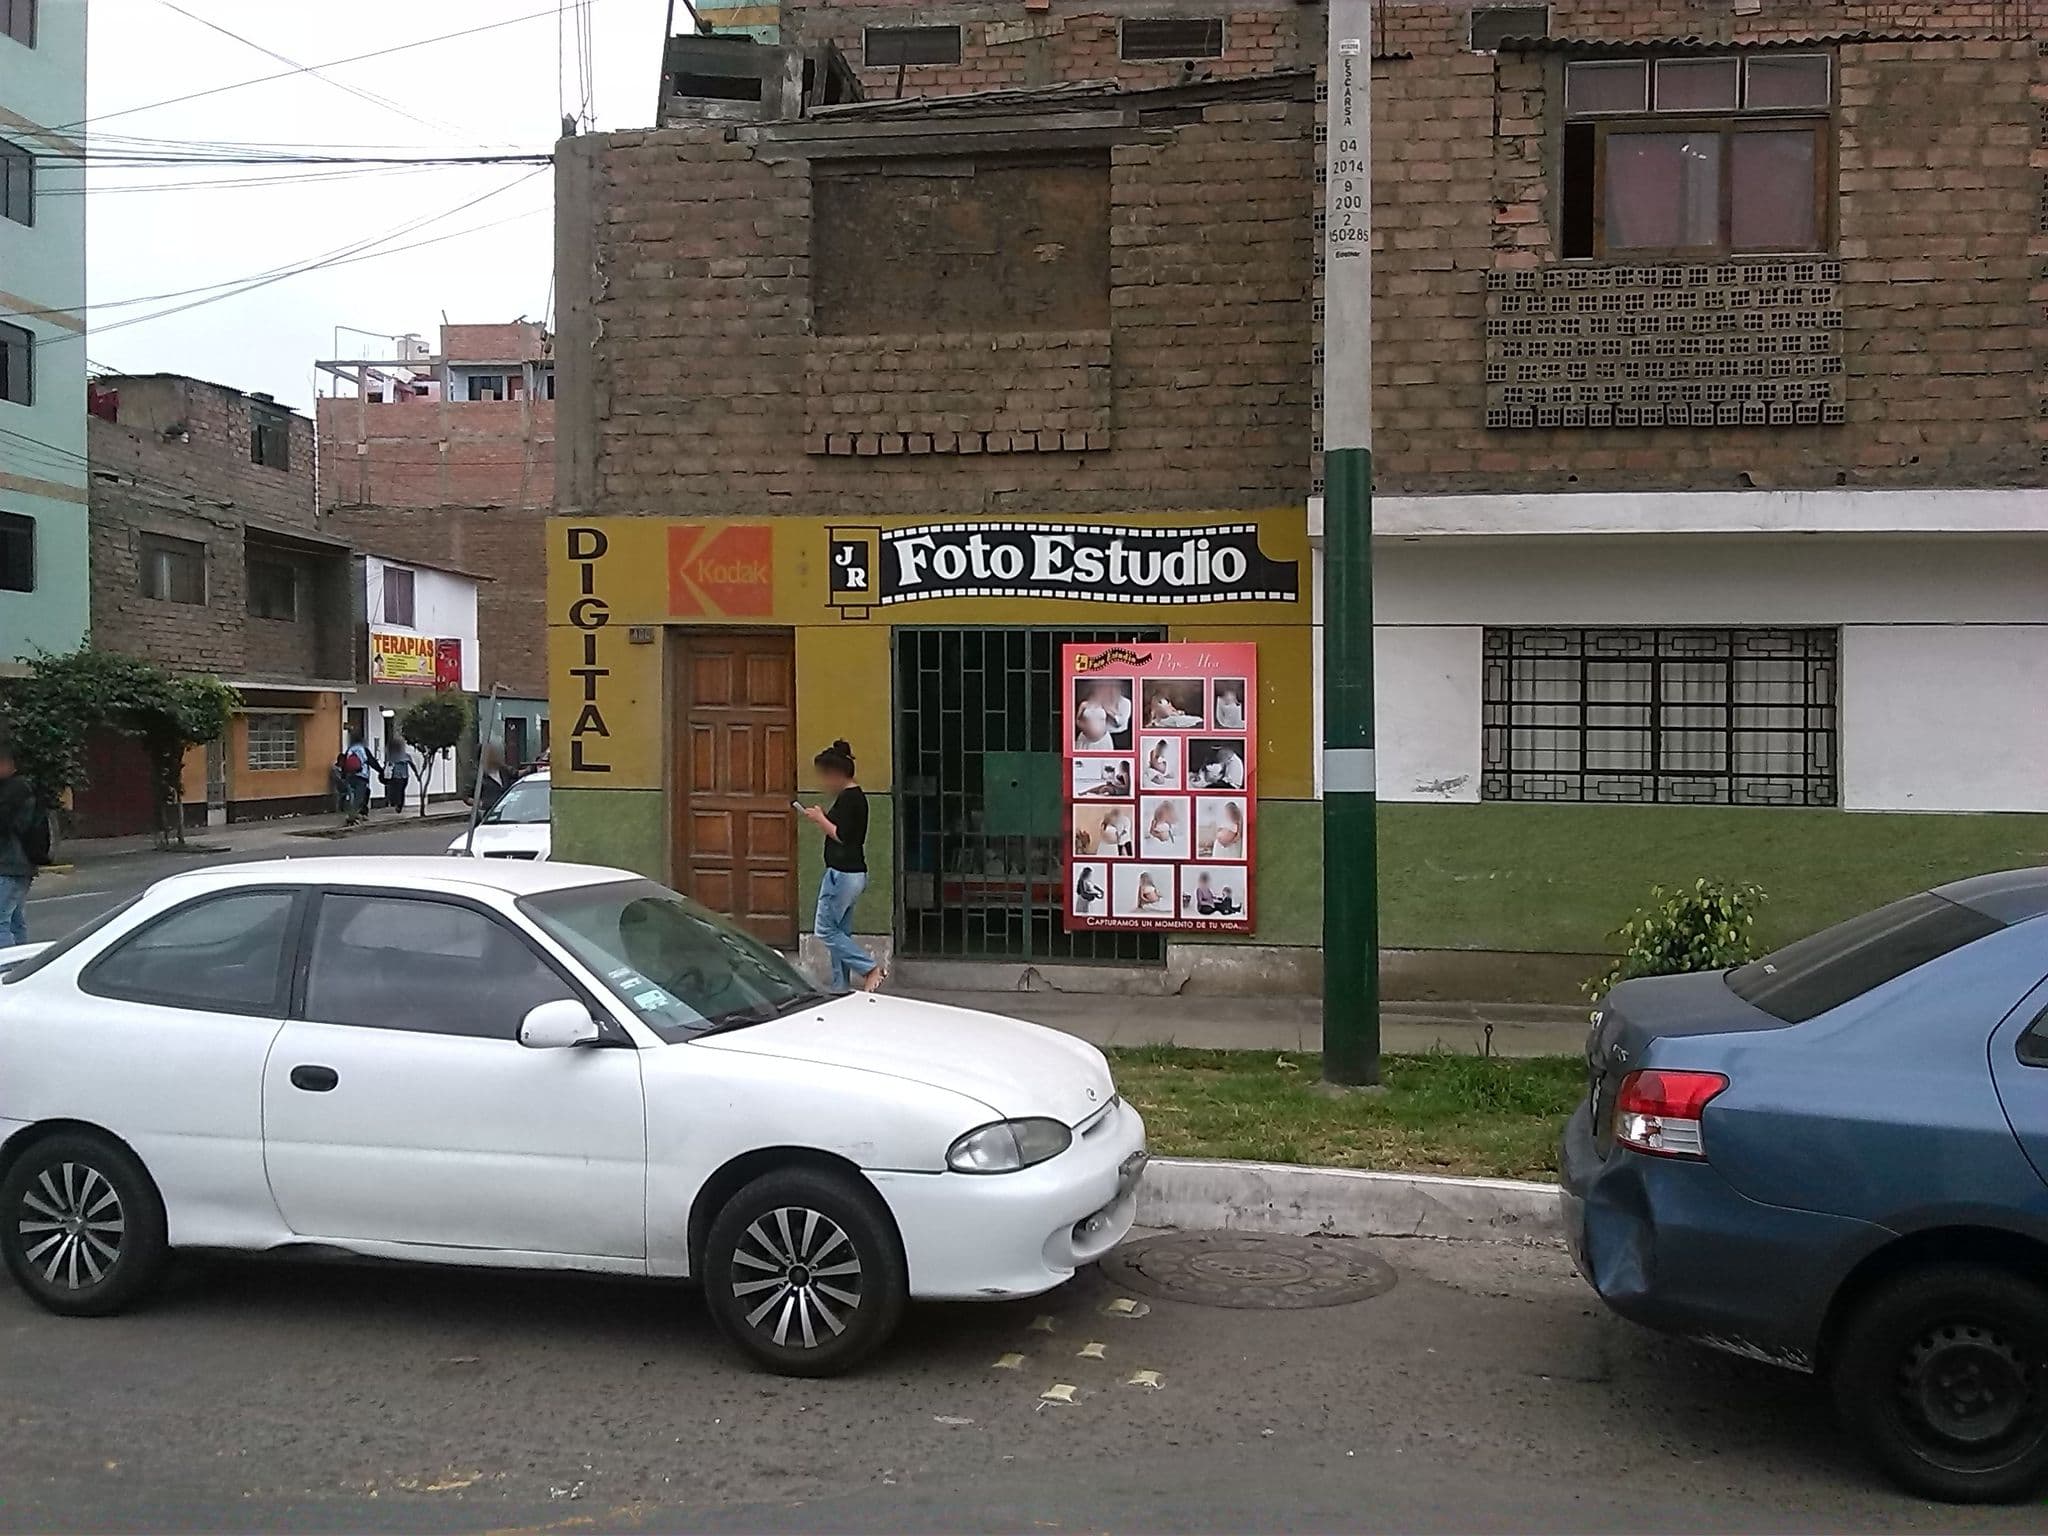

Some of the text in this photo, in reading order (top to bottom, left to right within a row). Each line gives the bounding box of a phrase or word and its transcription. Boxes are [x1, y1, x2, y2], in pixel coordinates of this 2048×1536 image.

[1344, 58, 1352, 127] ESCARSA
[1340, 139, 1357, 152] 04
[1333, 159, 1364, 174] 2014
[1344, 180, 1353, 192] 9
[1335, 195, 1362, 210] 200
[1343, 213, 1351, 226] 2
[894, 534, 1248, 587] Foto Estudio
[699, 559, 769, 584] Kodak
[373, 634, 435, 657] TERAPIAS
[567, 527, 612, 772] DIGITAL
[1086, 916, 1139, 927] CAPTURAMOS
[1141, 919, 1152, 927] UN
[1154, 920, 1194, 929] MOMENTO
[1196, 921, 1206, 929] DE
[1209, 921, 1218, 929] TU
